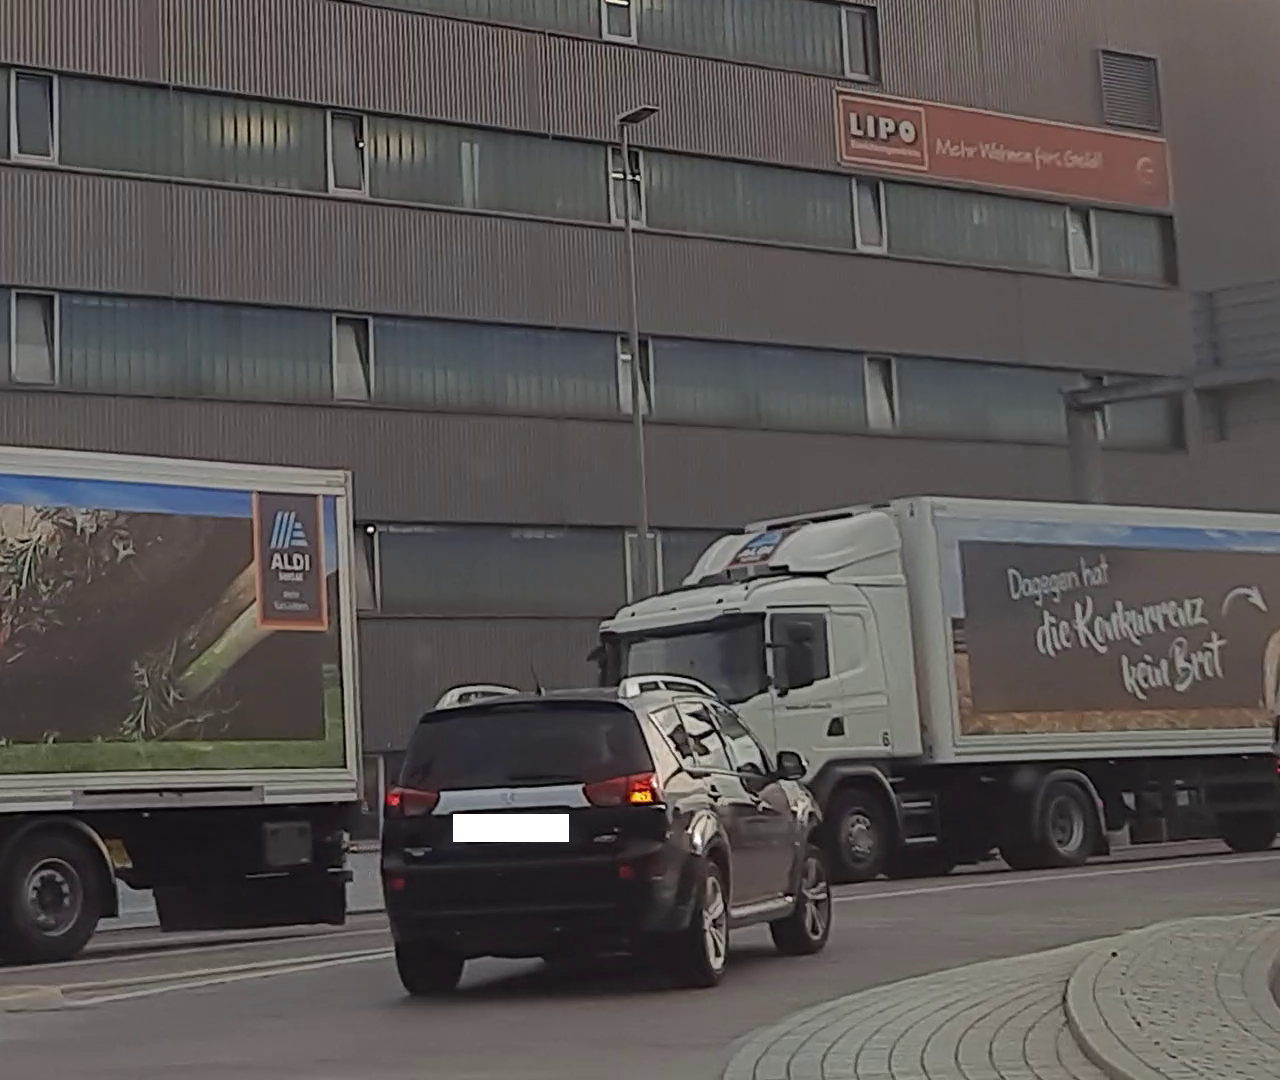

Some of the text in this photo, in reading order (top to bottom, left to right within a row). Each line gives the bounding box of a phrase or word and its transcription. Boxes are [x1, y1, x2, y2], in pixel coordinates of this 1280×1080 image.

[849, 112, 916, 144] LIPO
[935, 137, 977, 159] Mehr
[271, 552, 311, 571] ALDI
[1007, 553, 1109, 608] Dagegen hat
[1036, 595, 1209, 658] die Konkurrenz
[1121, 630, 1228, 701] kein Brot
